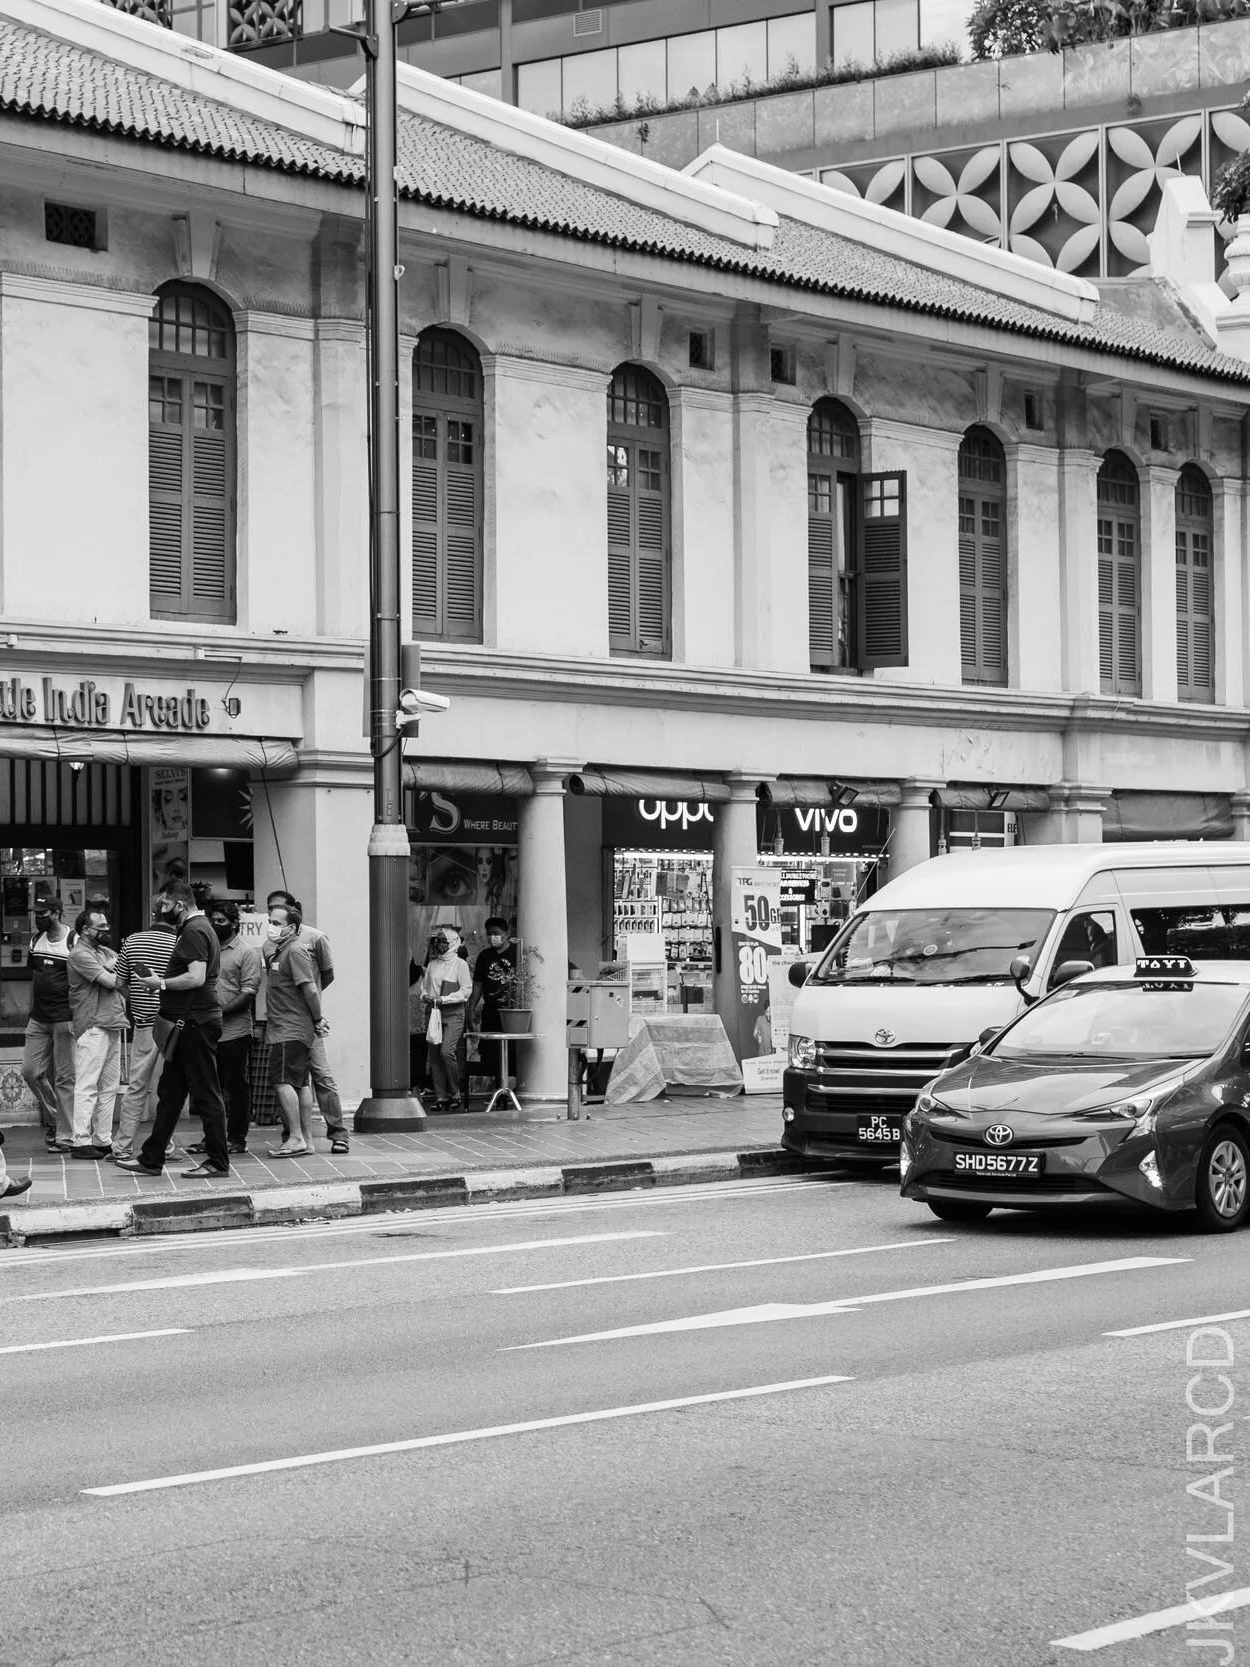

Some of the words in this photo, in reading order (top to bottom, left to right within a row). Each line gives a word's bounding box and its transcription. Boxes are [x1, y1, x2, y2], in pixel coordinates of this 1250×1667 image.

[43, 677, 111, 723] India
[120, 683, 210, 728] Arcade
[492, 819, 519, 831] BEAUT
[743, 894, 770, 932] 50
[240, 921, 264, 936] TRY
[739, 946, 767, 985] 80
[870, 1116, 888, 1128] PC
[955, 1154, 1039, 1172] SHD5677Z
